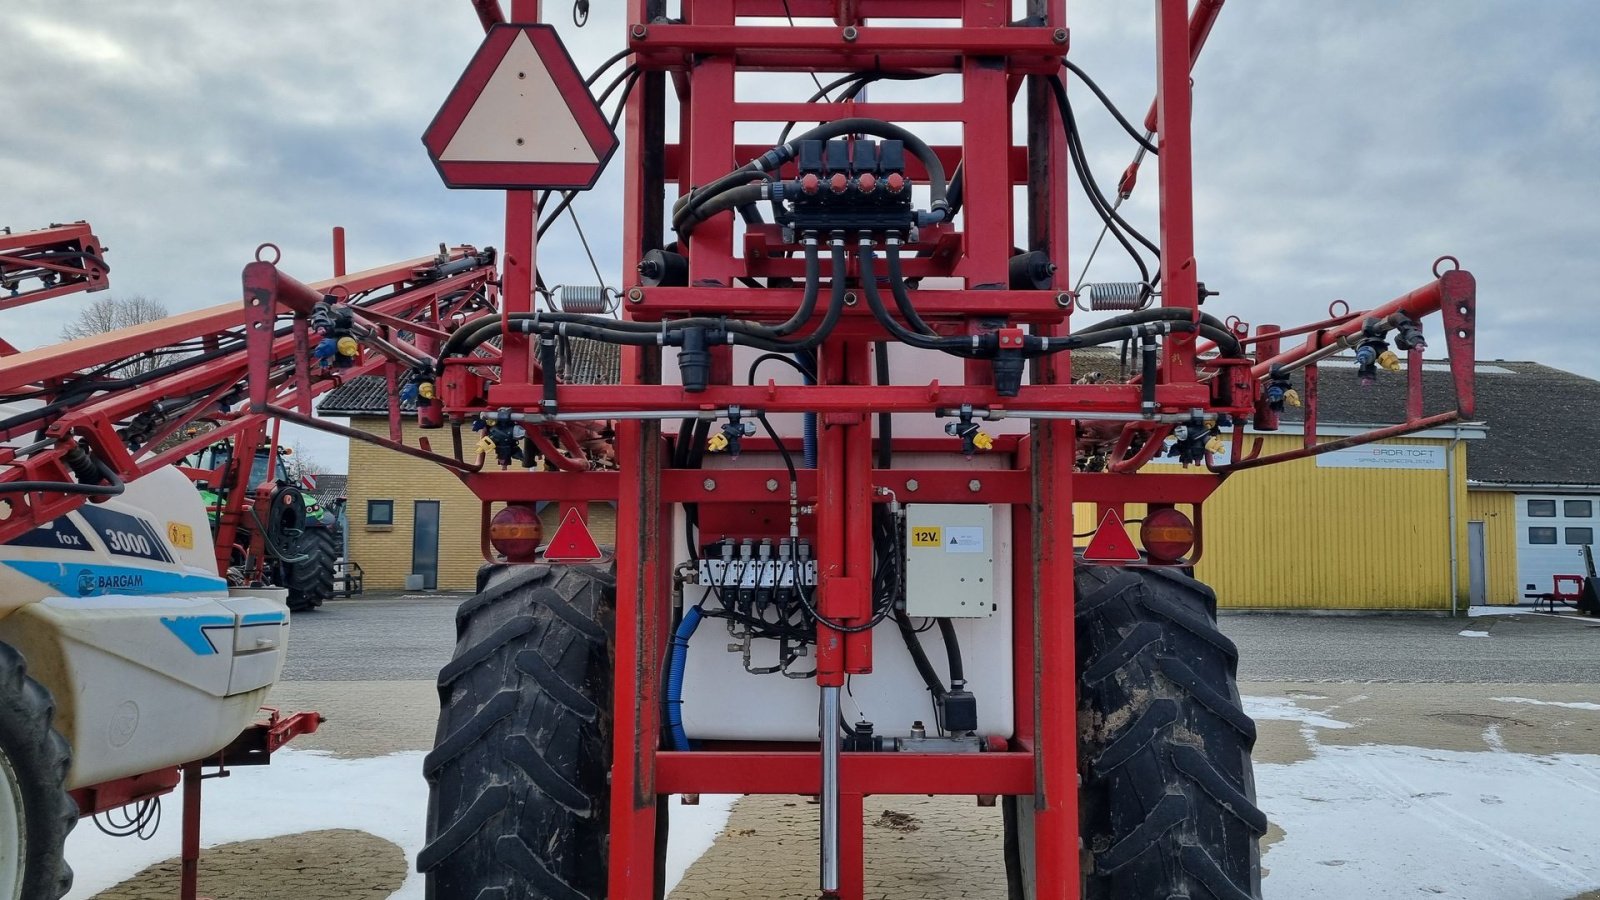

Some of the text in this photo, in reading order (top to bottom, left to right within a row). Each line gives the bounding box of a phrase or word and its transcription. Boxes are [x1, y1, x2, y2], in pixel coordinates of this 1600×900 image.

[56, 531, 80, 545] fox
[105, 529, 151, 556] 3000
[98, 576, 143, 588] BARGAM
